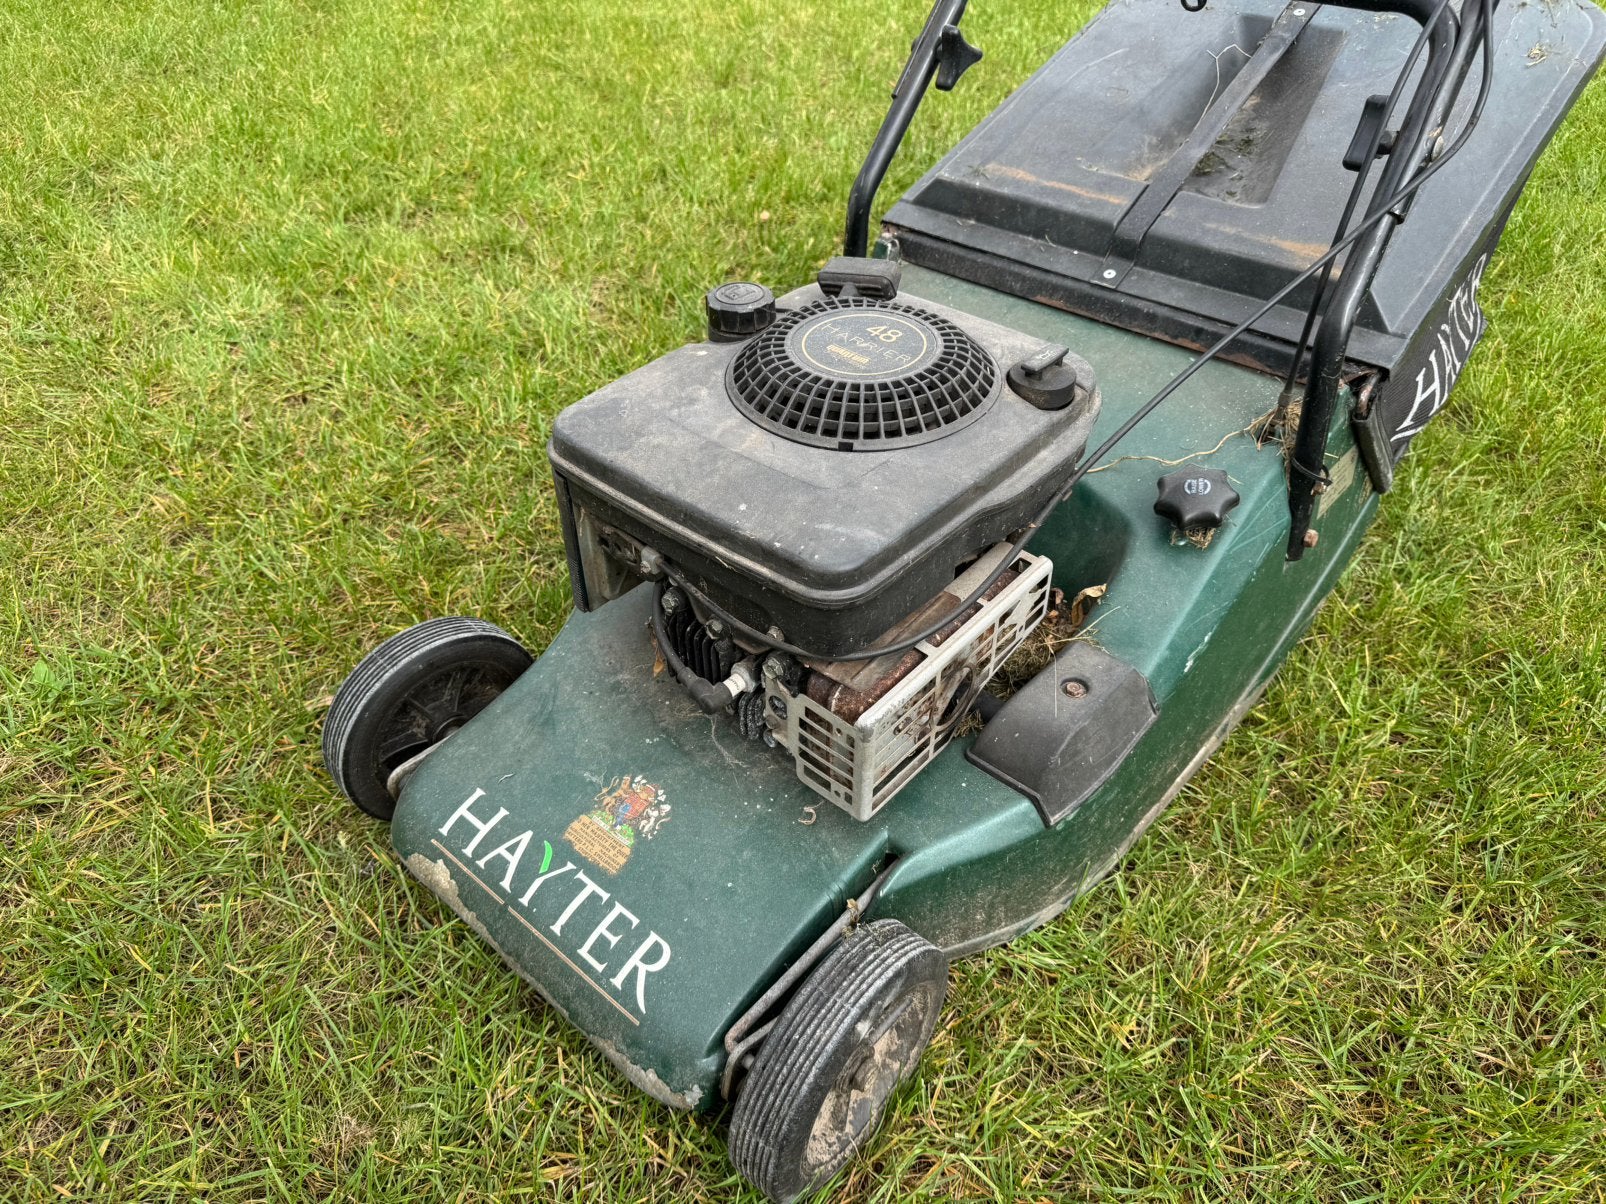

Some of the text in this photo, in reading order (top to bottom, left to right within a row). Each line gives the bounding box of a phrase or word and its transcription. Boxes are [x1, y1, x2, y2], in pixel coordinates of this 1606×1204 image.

[821, 322, 912, 363] HARRIER
[866, 324, 902, 343] 48
[438, 787, 671, 1015] HAYTER
